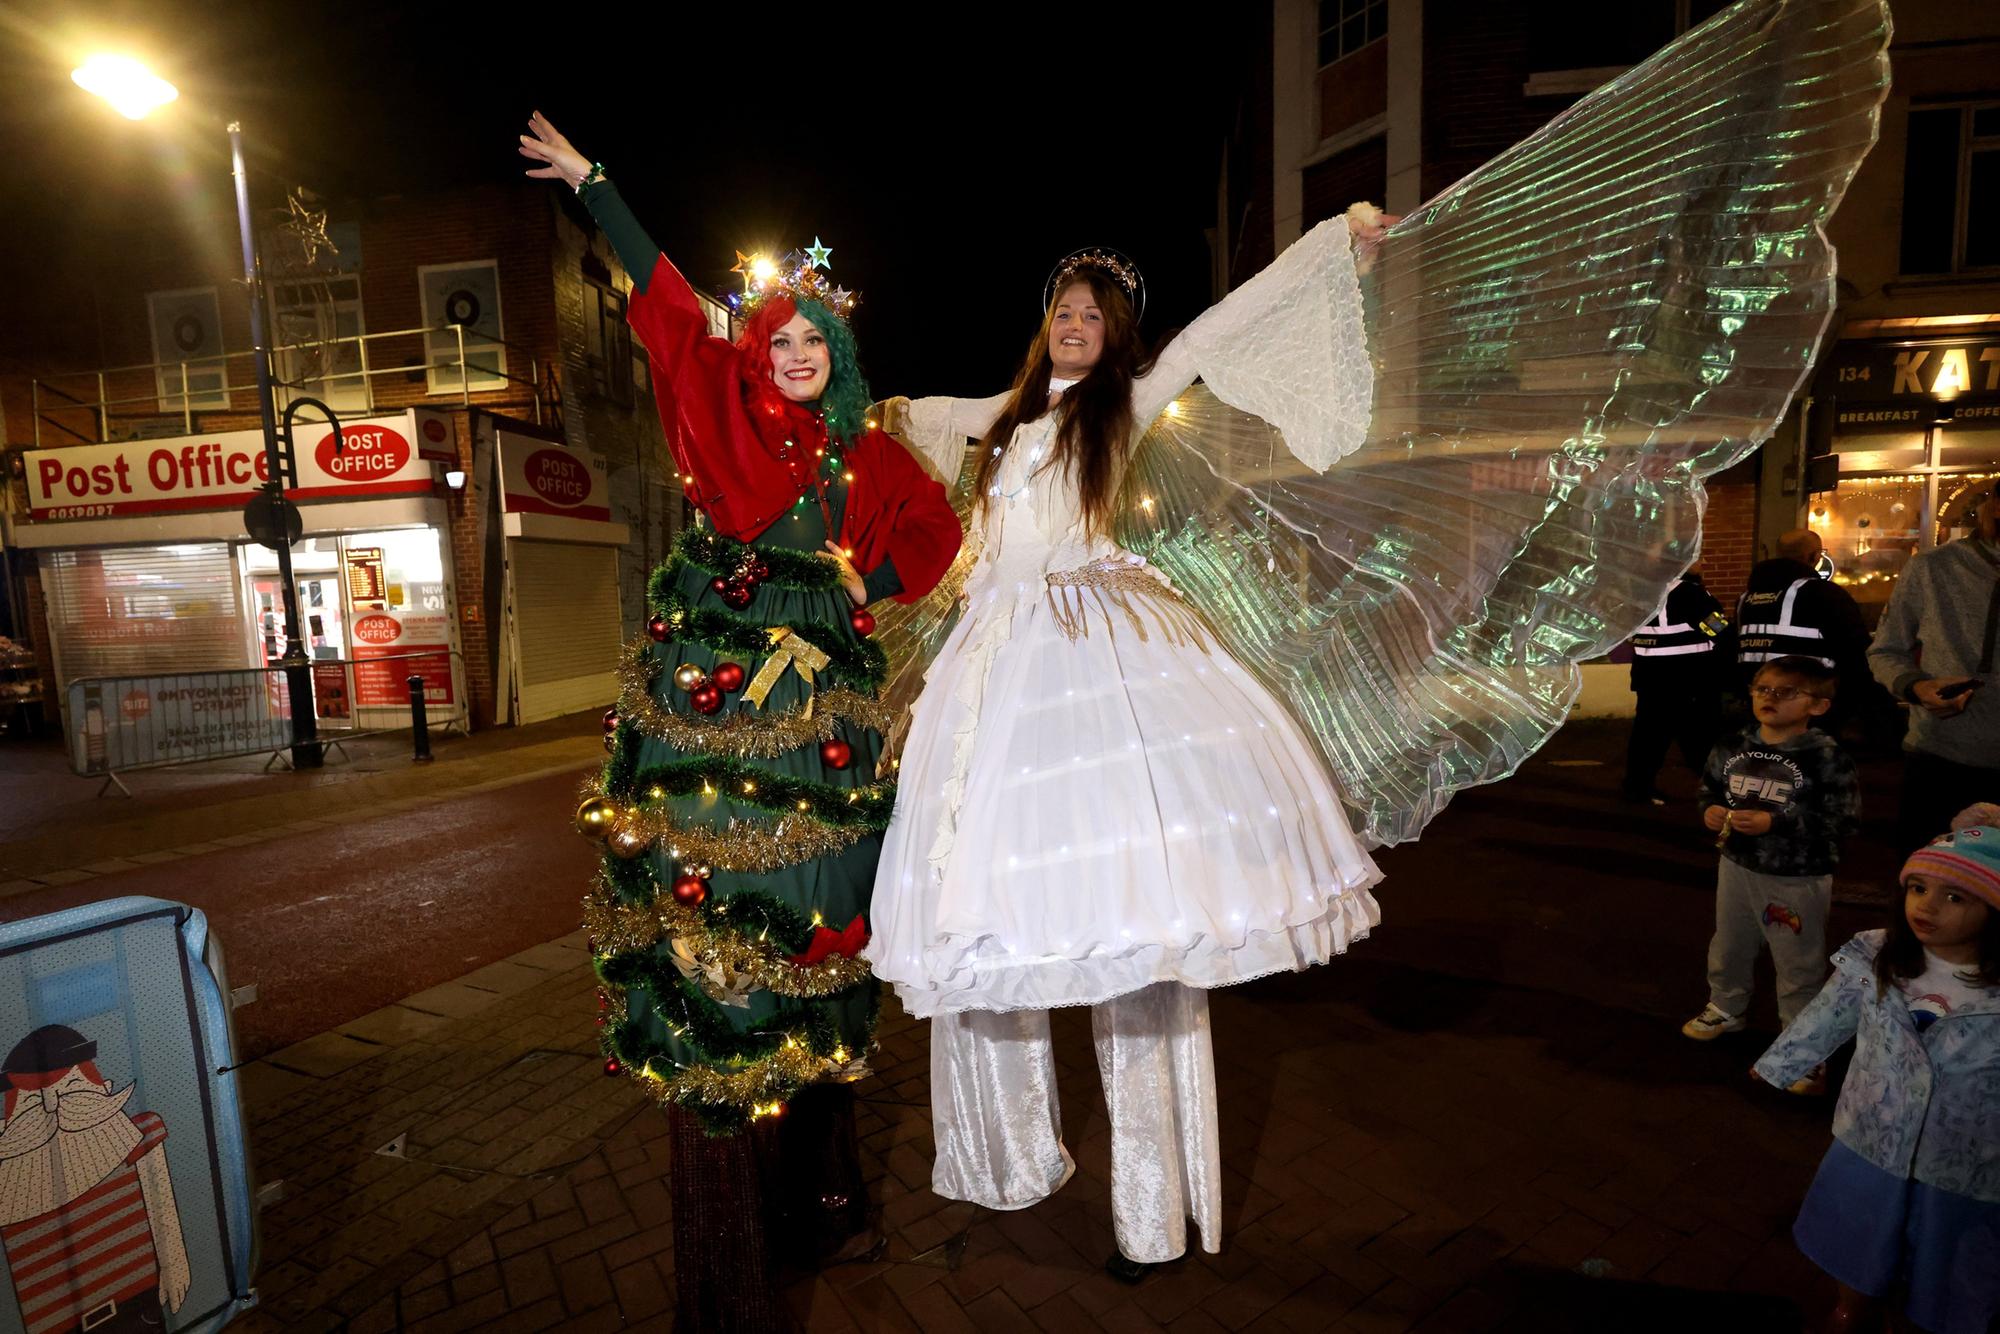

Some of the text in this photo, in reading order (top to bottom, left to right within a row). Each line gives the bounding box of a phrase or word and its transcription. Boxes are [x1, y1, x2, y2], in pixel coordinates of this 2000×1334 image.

[1839, 366, 1871, 382] 134
[1839, 410, 1920, 423] BREAKFAST
[38, 443, 270, 499] Post Office
[331, 453, 396, 474] OFFICE
[541, 458, 577, 479] POST
[537, 475, 584, 497] OFFICE
[421, 586, 443, 595] NEW
[360, 629, 397, 640] OFFICE
[363, 619, 391, 629] POST
[1747, 751, 1784, 763] YOUR
[1783, 758, 1805, 789] LIMITS
[1728, 774, 1794, 805] EPIC
